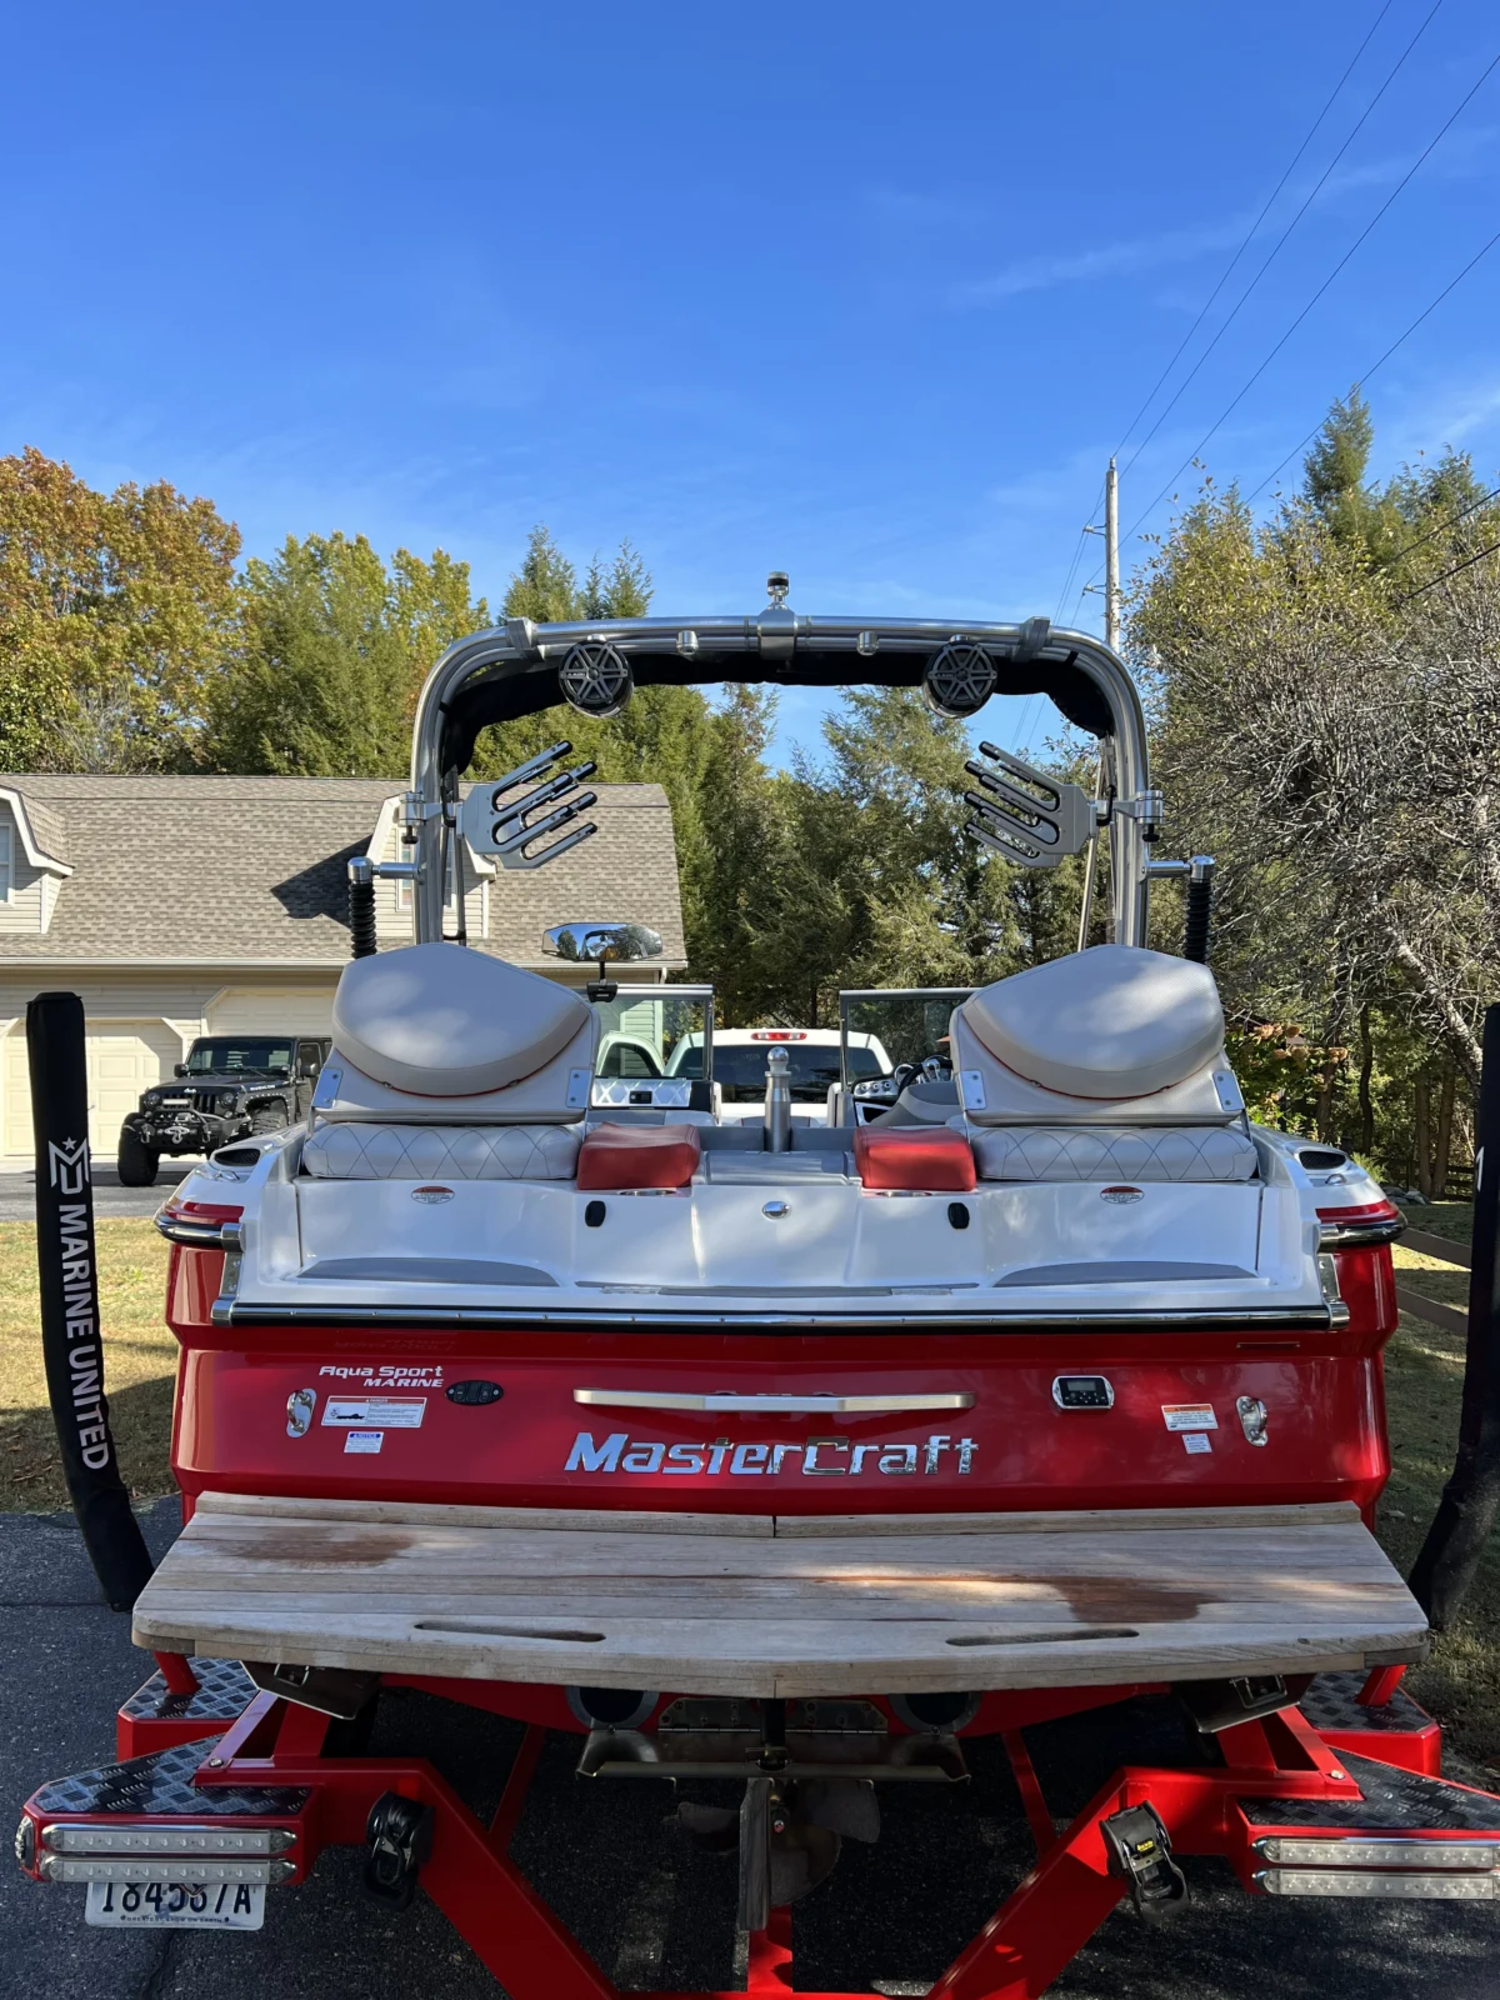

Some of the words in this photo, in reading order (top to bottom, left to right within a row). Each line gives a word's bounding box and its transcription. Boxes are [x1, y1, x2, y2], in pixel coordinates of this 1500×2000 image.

[58, 1203, 94, 1339] MARINE
[318, 1365, 374, 1379] Aqua
[378, 1365, 443, 1379] Sport
[363, 1378, 444, 1388] MARINE
[68, 1344, 110, 1470] UNITED
[563, 1431, 980, 1476] MasterCraft
